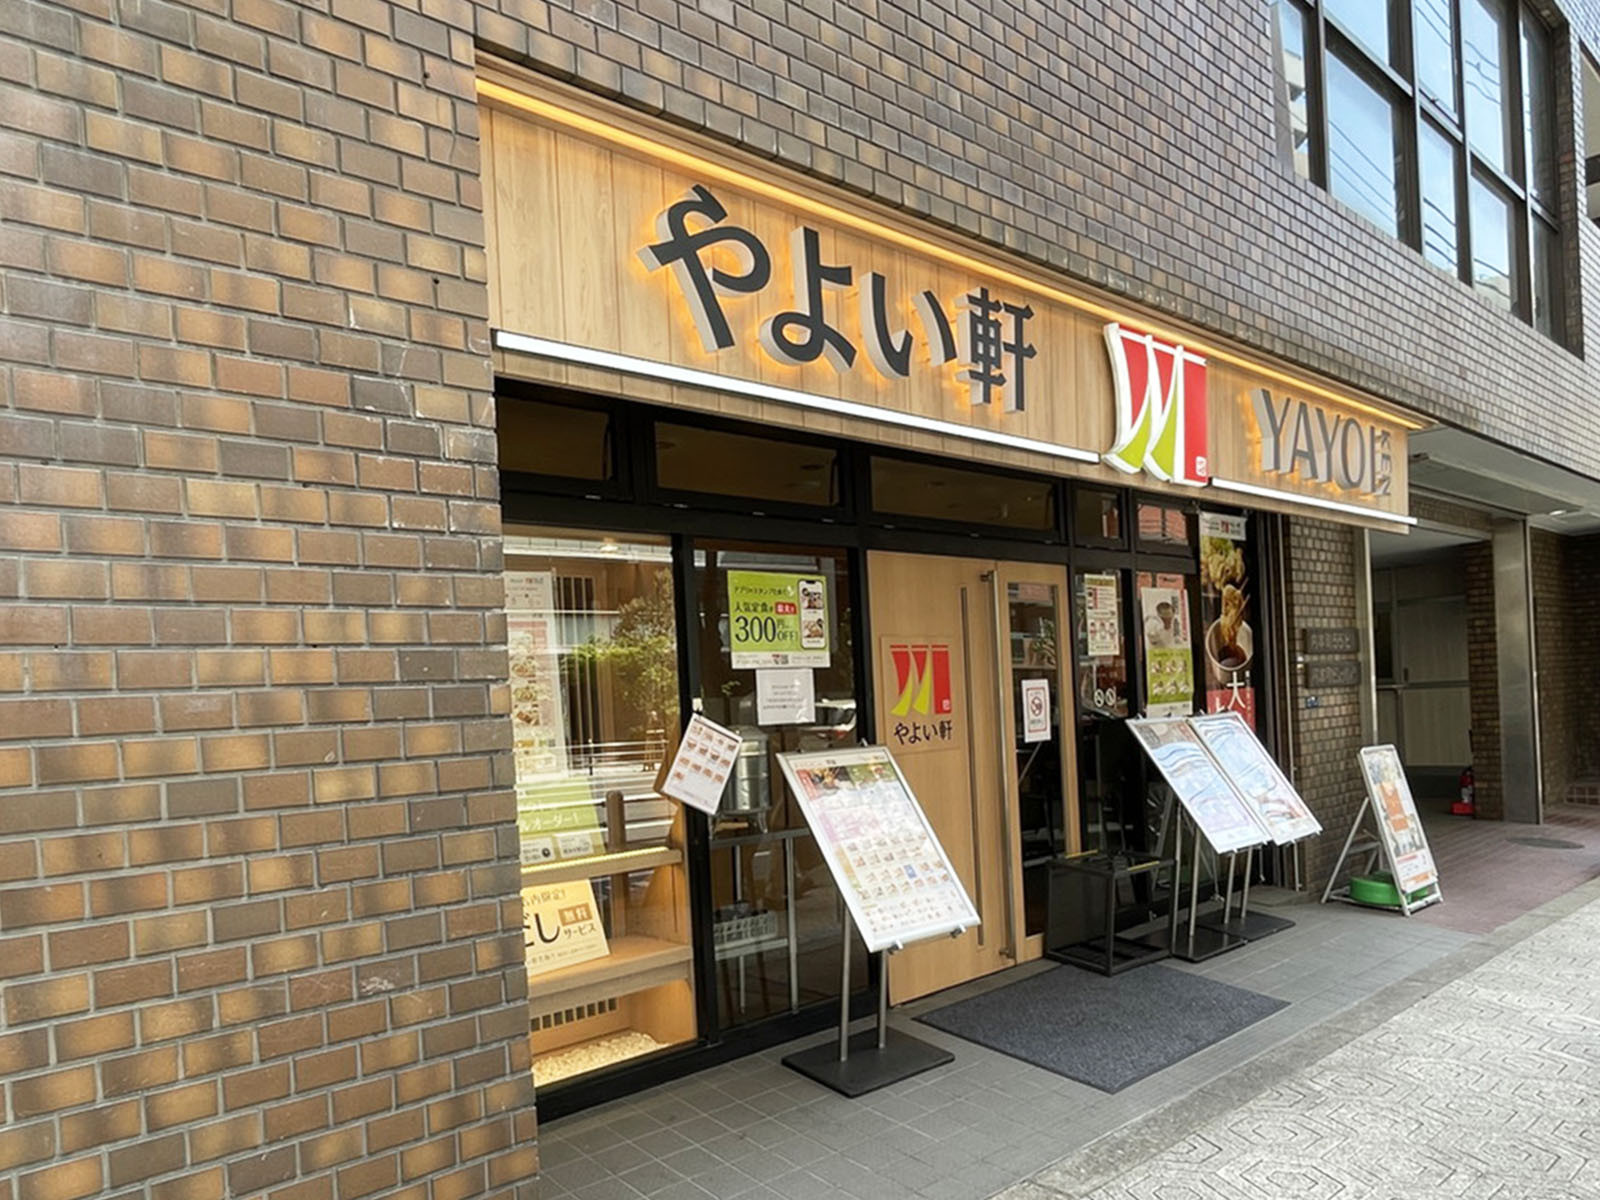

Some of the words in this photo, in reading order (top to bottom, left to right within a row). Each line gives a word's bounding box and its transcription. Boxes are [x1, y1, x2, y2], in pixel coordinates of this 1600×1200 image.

[638, 184, 1037, 413] やよい軒
[1254, 388, 1376, 494] YAYOI
[735, 615, 776, 643] 300
[894, 720, 952, 745] やよい軒
[563, 922, 597, 940] サービス
